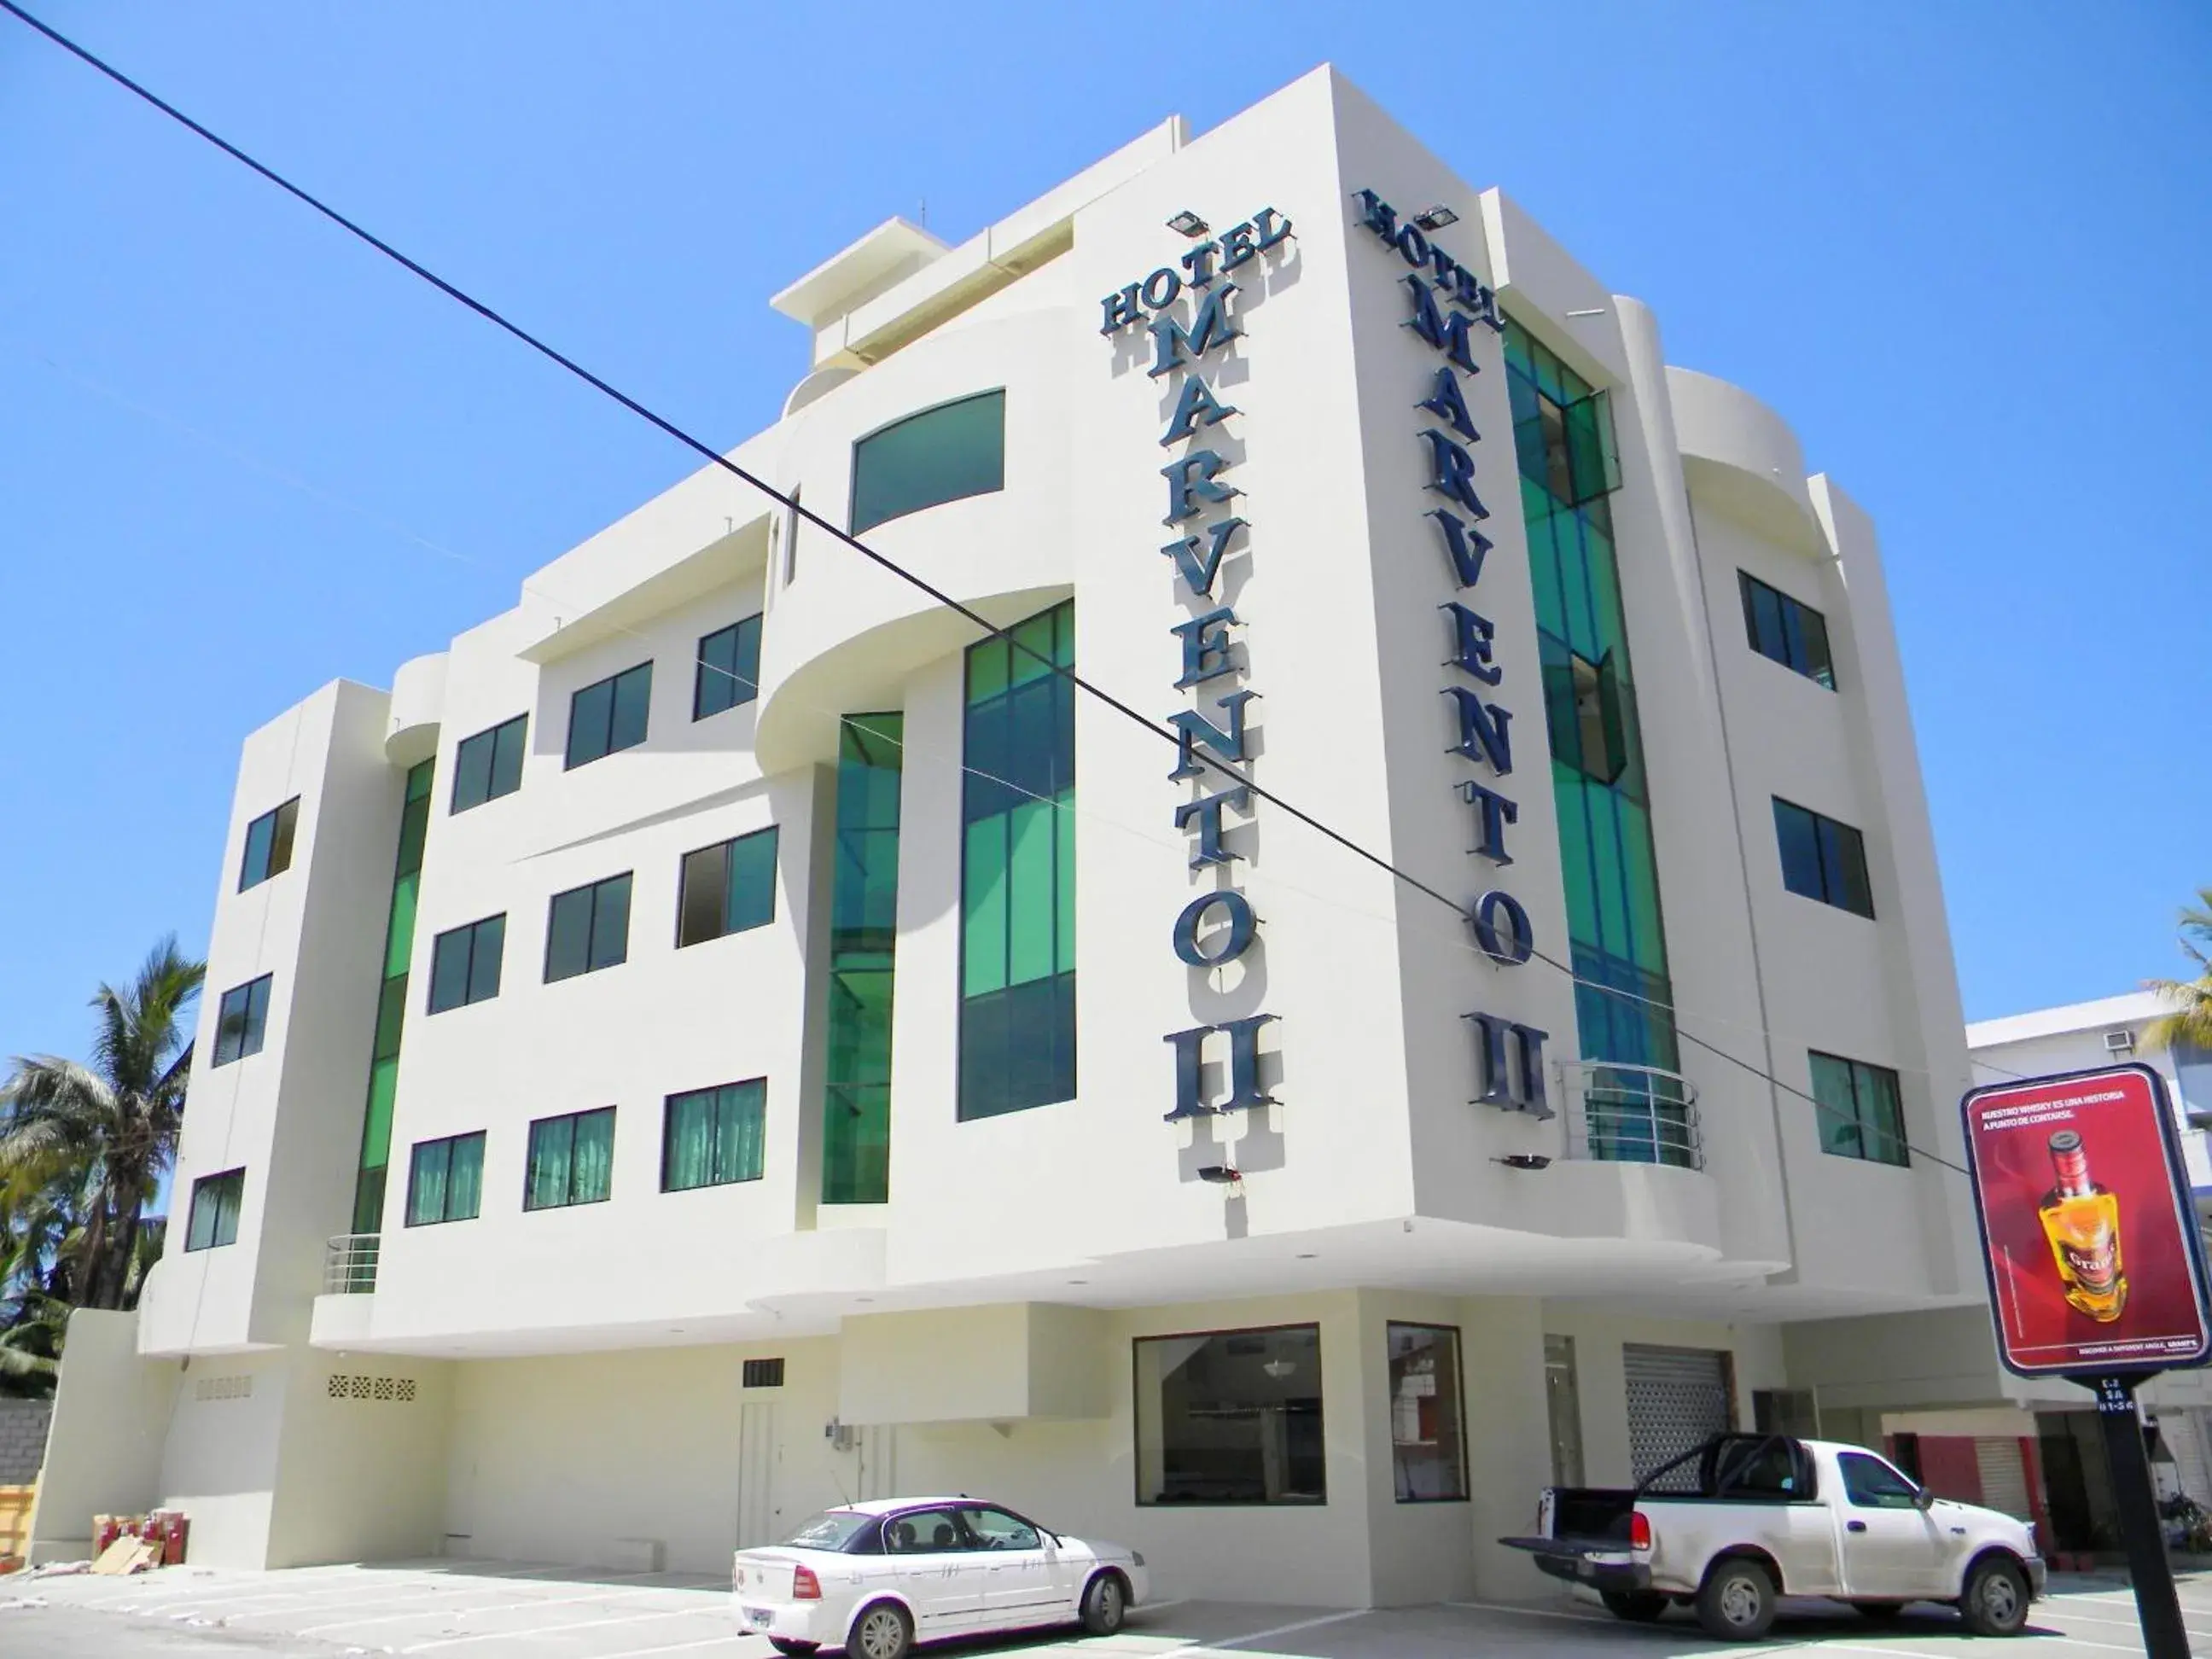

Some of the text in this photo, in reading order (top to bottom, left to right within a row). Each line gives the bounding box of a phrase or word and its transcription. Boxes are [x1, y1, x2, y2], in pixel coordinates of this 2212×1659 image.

[1099, 207, 1295, 338] HOTEL
[1355, 189, 1506, 334] HOTEL
[1147, 282, 1262, 968] MARVENTO
[1400, 273, 1534, 967] MARVENTO
[1162, 1013, 1283, 1123] II
